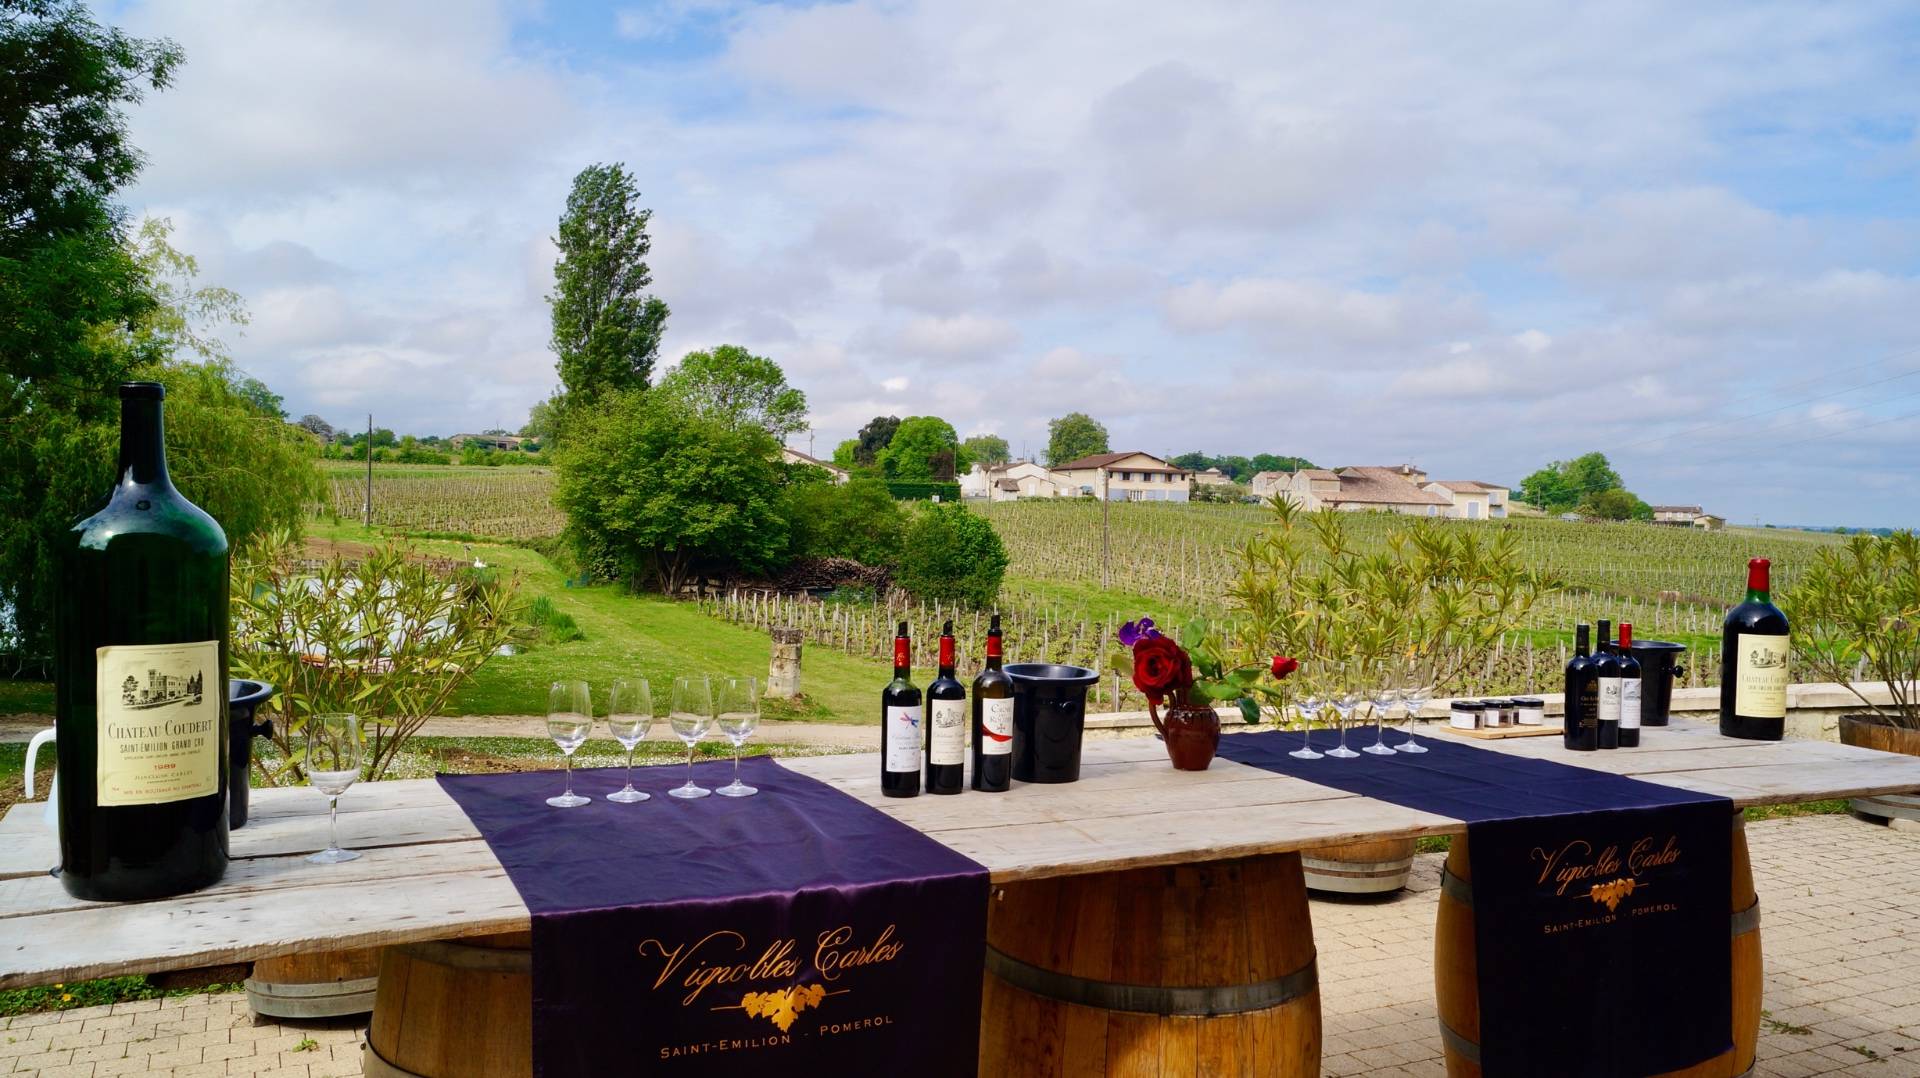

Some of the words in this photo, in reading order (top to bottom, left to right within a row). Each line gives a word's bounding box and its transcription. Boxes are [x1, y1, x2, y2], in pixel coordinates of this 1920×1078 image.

[165, 719, 213, 737] COUDERT
[171, 740, 192, 751] GRAND
[194, 737, 204, 748] CRU
[1530, 840, 1622, 896] Vignobles
[1628, 835, 1680, 876] Carles
[1544, 914, 1617, 934] SAINT-EMILION
[1632, 903, 1678, 916] POMEROL
[639, 930, 802, 1006] Vignobles
[814, 925, 904, 981] Carles
[660, 1034, 791, 1059] SAINT-EMILION
[820, 1015, 893, 1036] POMEROL
